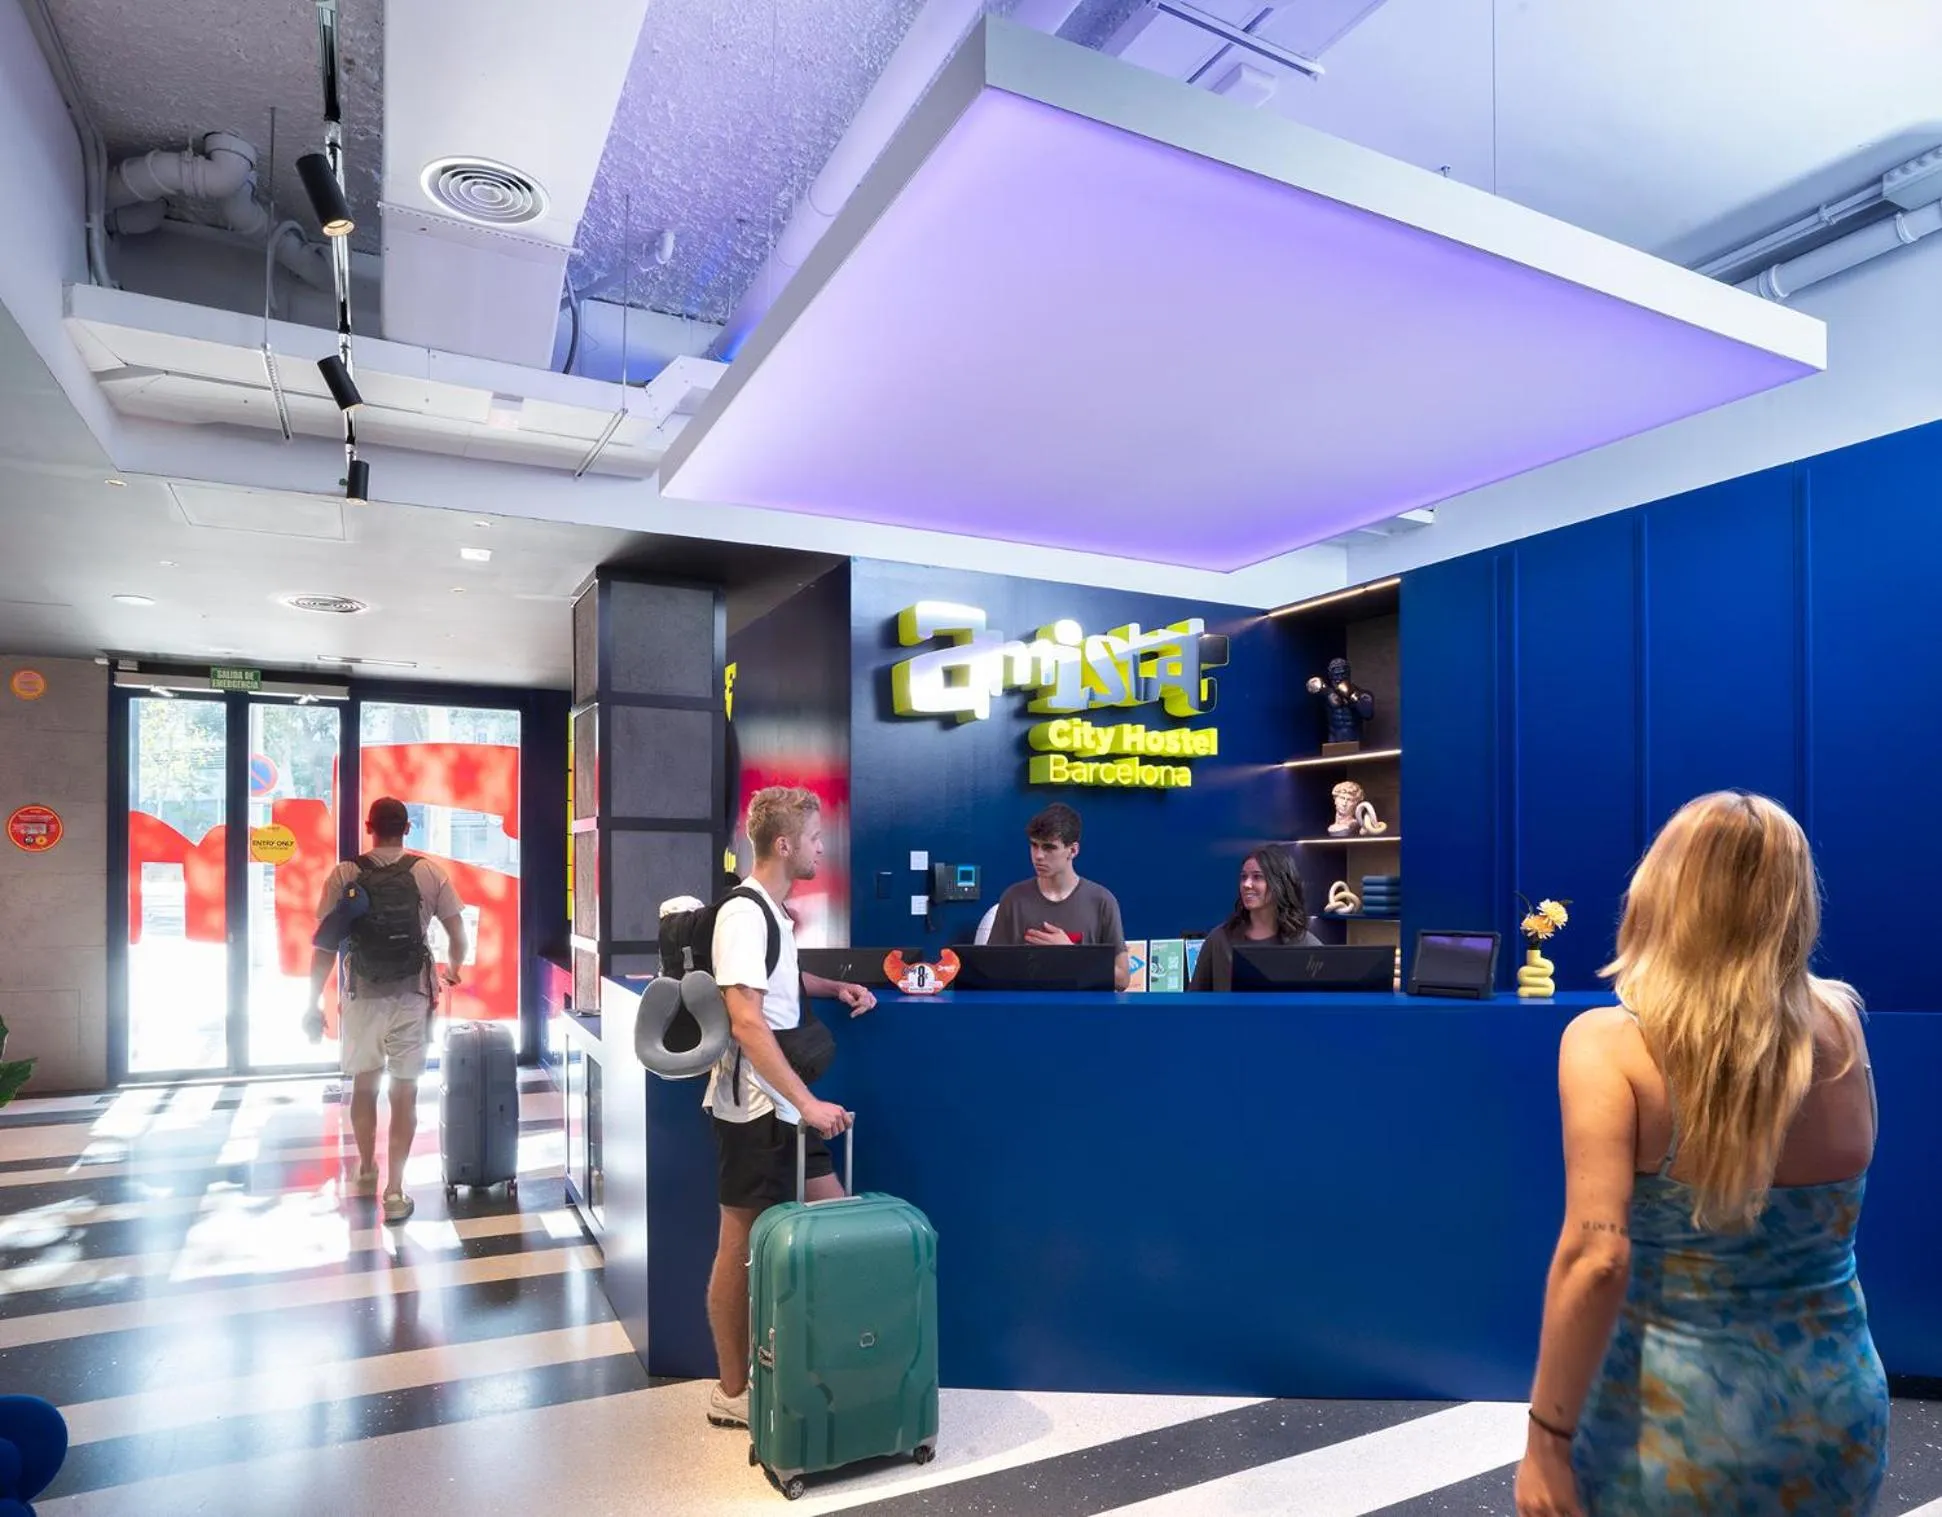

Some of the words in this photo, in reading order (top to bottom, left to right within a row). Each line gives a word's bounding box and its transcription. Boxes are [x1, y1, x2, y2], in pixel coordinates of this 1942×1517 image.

[1039, 718, 1115, 757] City
[1122, 724, 1218, 757] Hostel
[1040, 755, 1191, 788] Barcelona
[252, 840, 275, 848] ENTRY
[276, 840, 295, 848] ONLY
